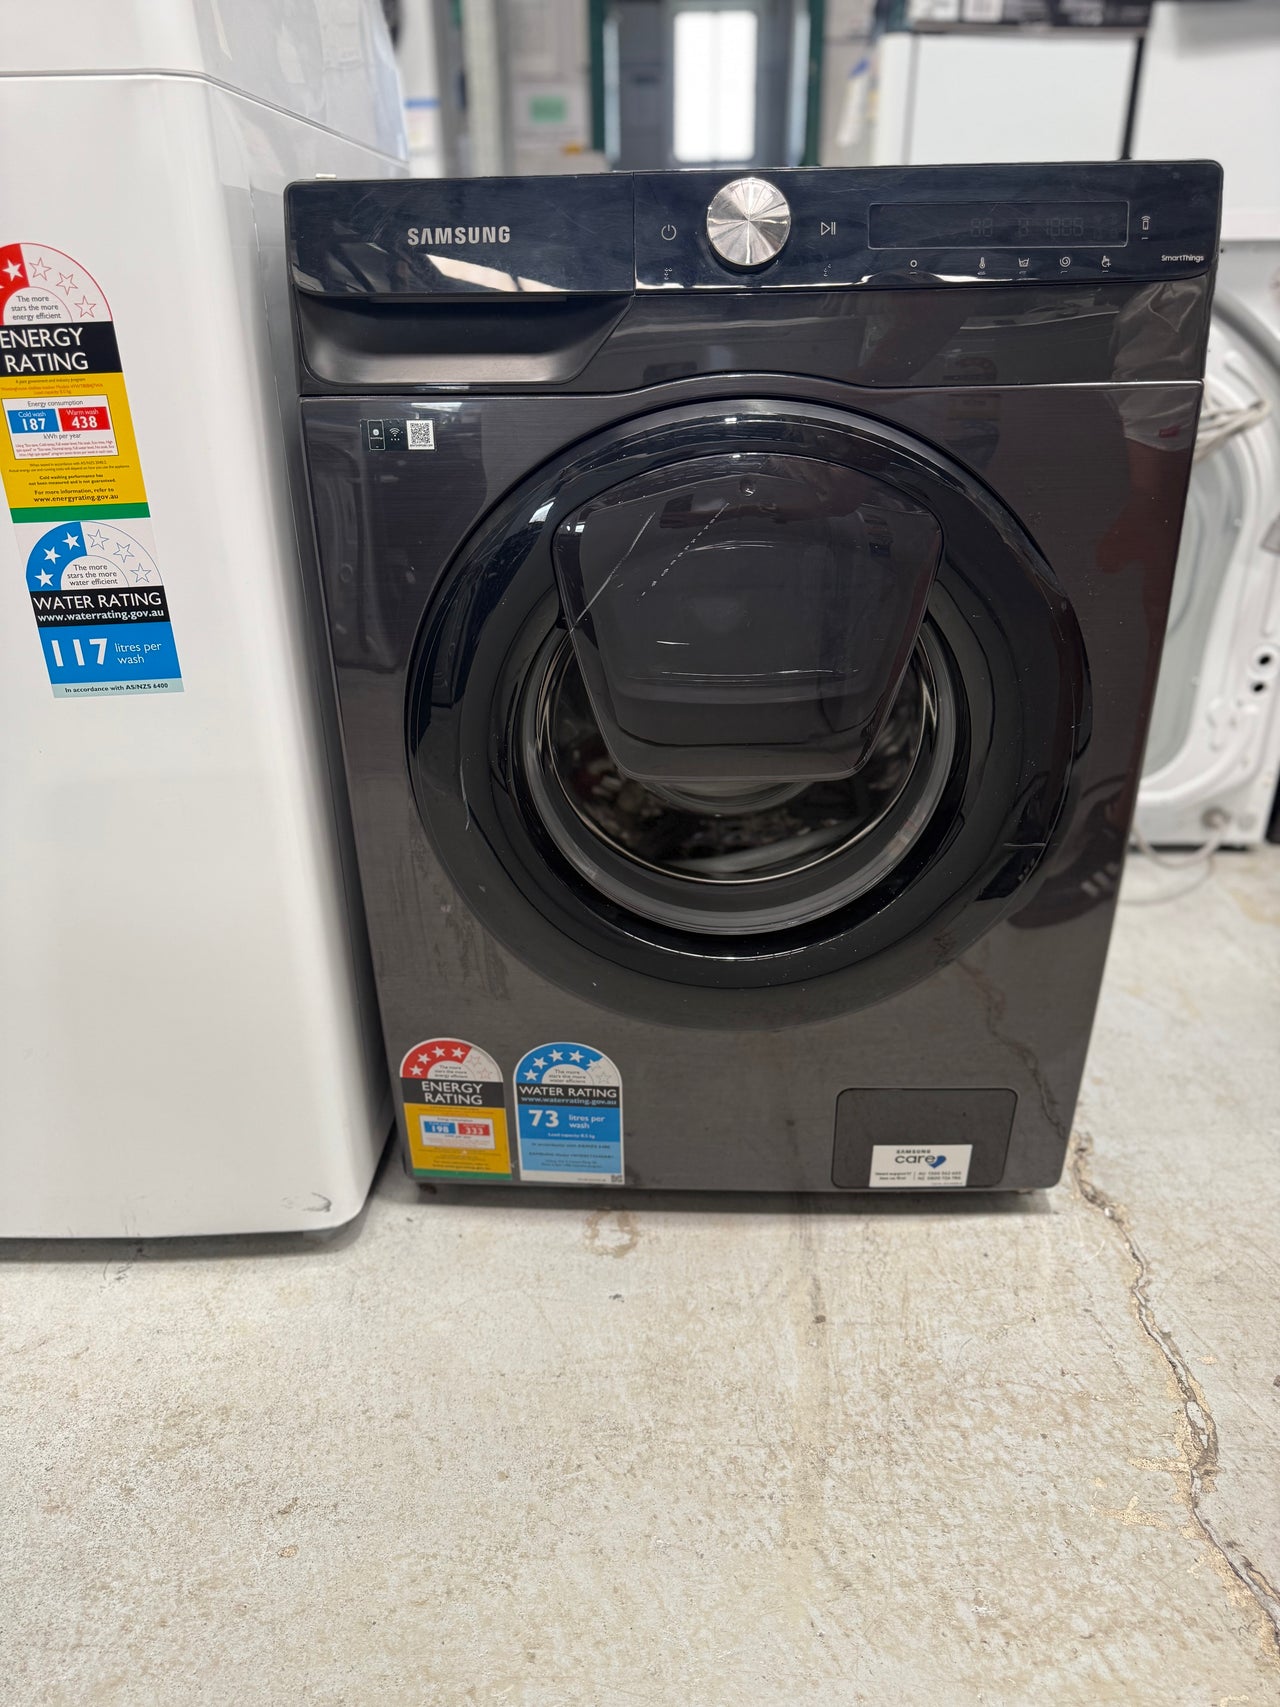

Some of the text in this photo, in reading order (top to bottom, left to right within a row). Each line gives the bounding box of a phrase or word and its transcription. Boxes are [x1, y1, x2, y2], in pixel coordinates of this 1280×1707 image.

[408, 226, 510, 246] SAMSUNG
[1161, 254, 1204, 264] SmartThings
[12, 314, 34, 322] energy
[0, 328, 83, 348] ENERGY
[4, 352, 89, 372] RATING
[22, 418, 46, 431] 187
[71, 416, 98, 429] 438
[34, 494, 119, 502] www.energyrating.gov.au
[32, 592, 162, 610] WATER RATING
[37, 609, 164, 622] www.waterrating.gov.au
[51, 638, 108, 667] 117
[115, 642, 162, 654] litres per
[118, 654, 144, 664] wash
[422, 1081, 482, 1093] ENERGY
[520, 1086, 617, 1098] WATER RATING
[425, 1093, 482, 1105] RATING
[521, 1096, 617, 1105] www.waterrating.gov.au
[528, 1110, 559, 1128] 73
[895, 1155, 936, 1164] care
